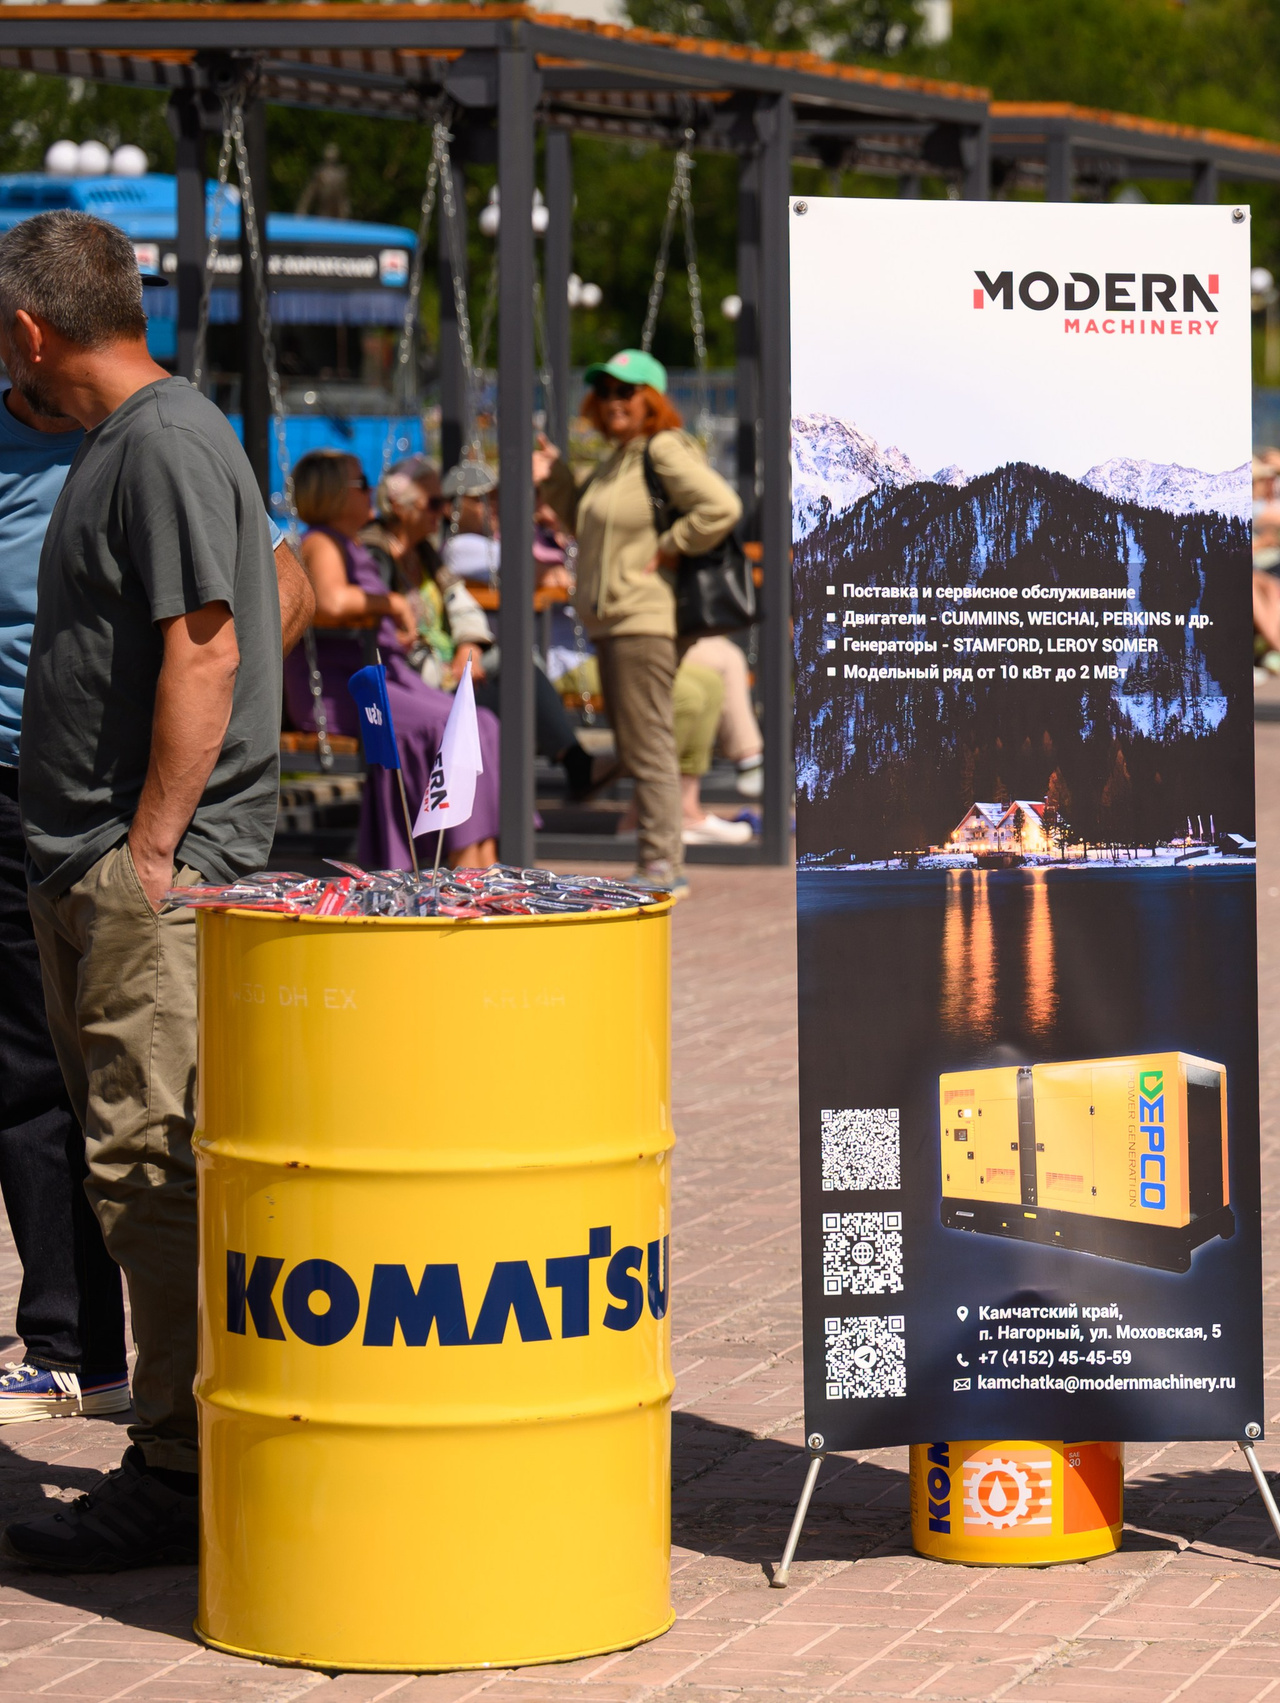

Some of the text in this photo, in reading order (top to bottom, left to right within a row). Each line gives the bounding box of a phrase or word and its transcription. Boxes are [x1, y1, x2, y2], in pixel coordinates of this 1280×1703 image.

[973, 270, 1219, 312] MODERN
[1064, 319, 1219, 335] MACHINERY
[843, 584, 1135, 602] Поставка и сервисное обслуживание
[843, 611, 926, 627] Двигатели
[941, 611, 1024, 628] CUMMINS,
[1028, 611, 1099, 628] WEICHAI,
[1103, 611, 1171, 626] PERKINS
[1175, 615, 1185, 626] и
[1189, 615, 1213, 629] др.
[843, 638, 937, 655] Генераторы
[953, 638, 1043, 655] STAMFORD,
[1047, 638, 1097, 653] LEROY
[1102, 638, 1158, 653] SOMER
[843, 664, 1127, 682] Модельный ряд от 10 кВт до 2 МВт
[279, 986, 308, 1008] DH
[324, 988, 357, 1010] EX
[1127, 1071, 1137, 1208] POWER GENERATION
[1139, 1070, 1167, 1211] DEPCO
[226, 1225, 670, 1348] KOMATSU
[979, 1303, 1123, 1322] Камчатский край,
[979, 1324, 1222, 1342] п. Нагорный, ул. Моховская, 5
[978, 1350, 1132, 1368] +7 (4152) 45-45-59
[977, 1374, 1236, 1393] kamchatka@modernmachinery.ru
[1069, 1458, 1081, 1467] 30
